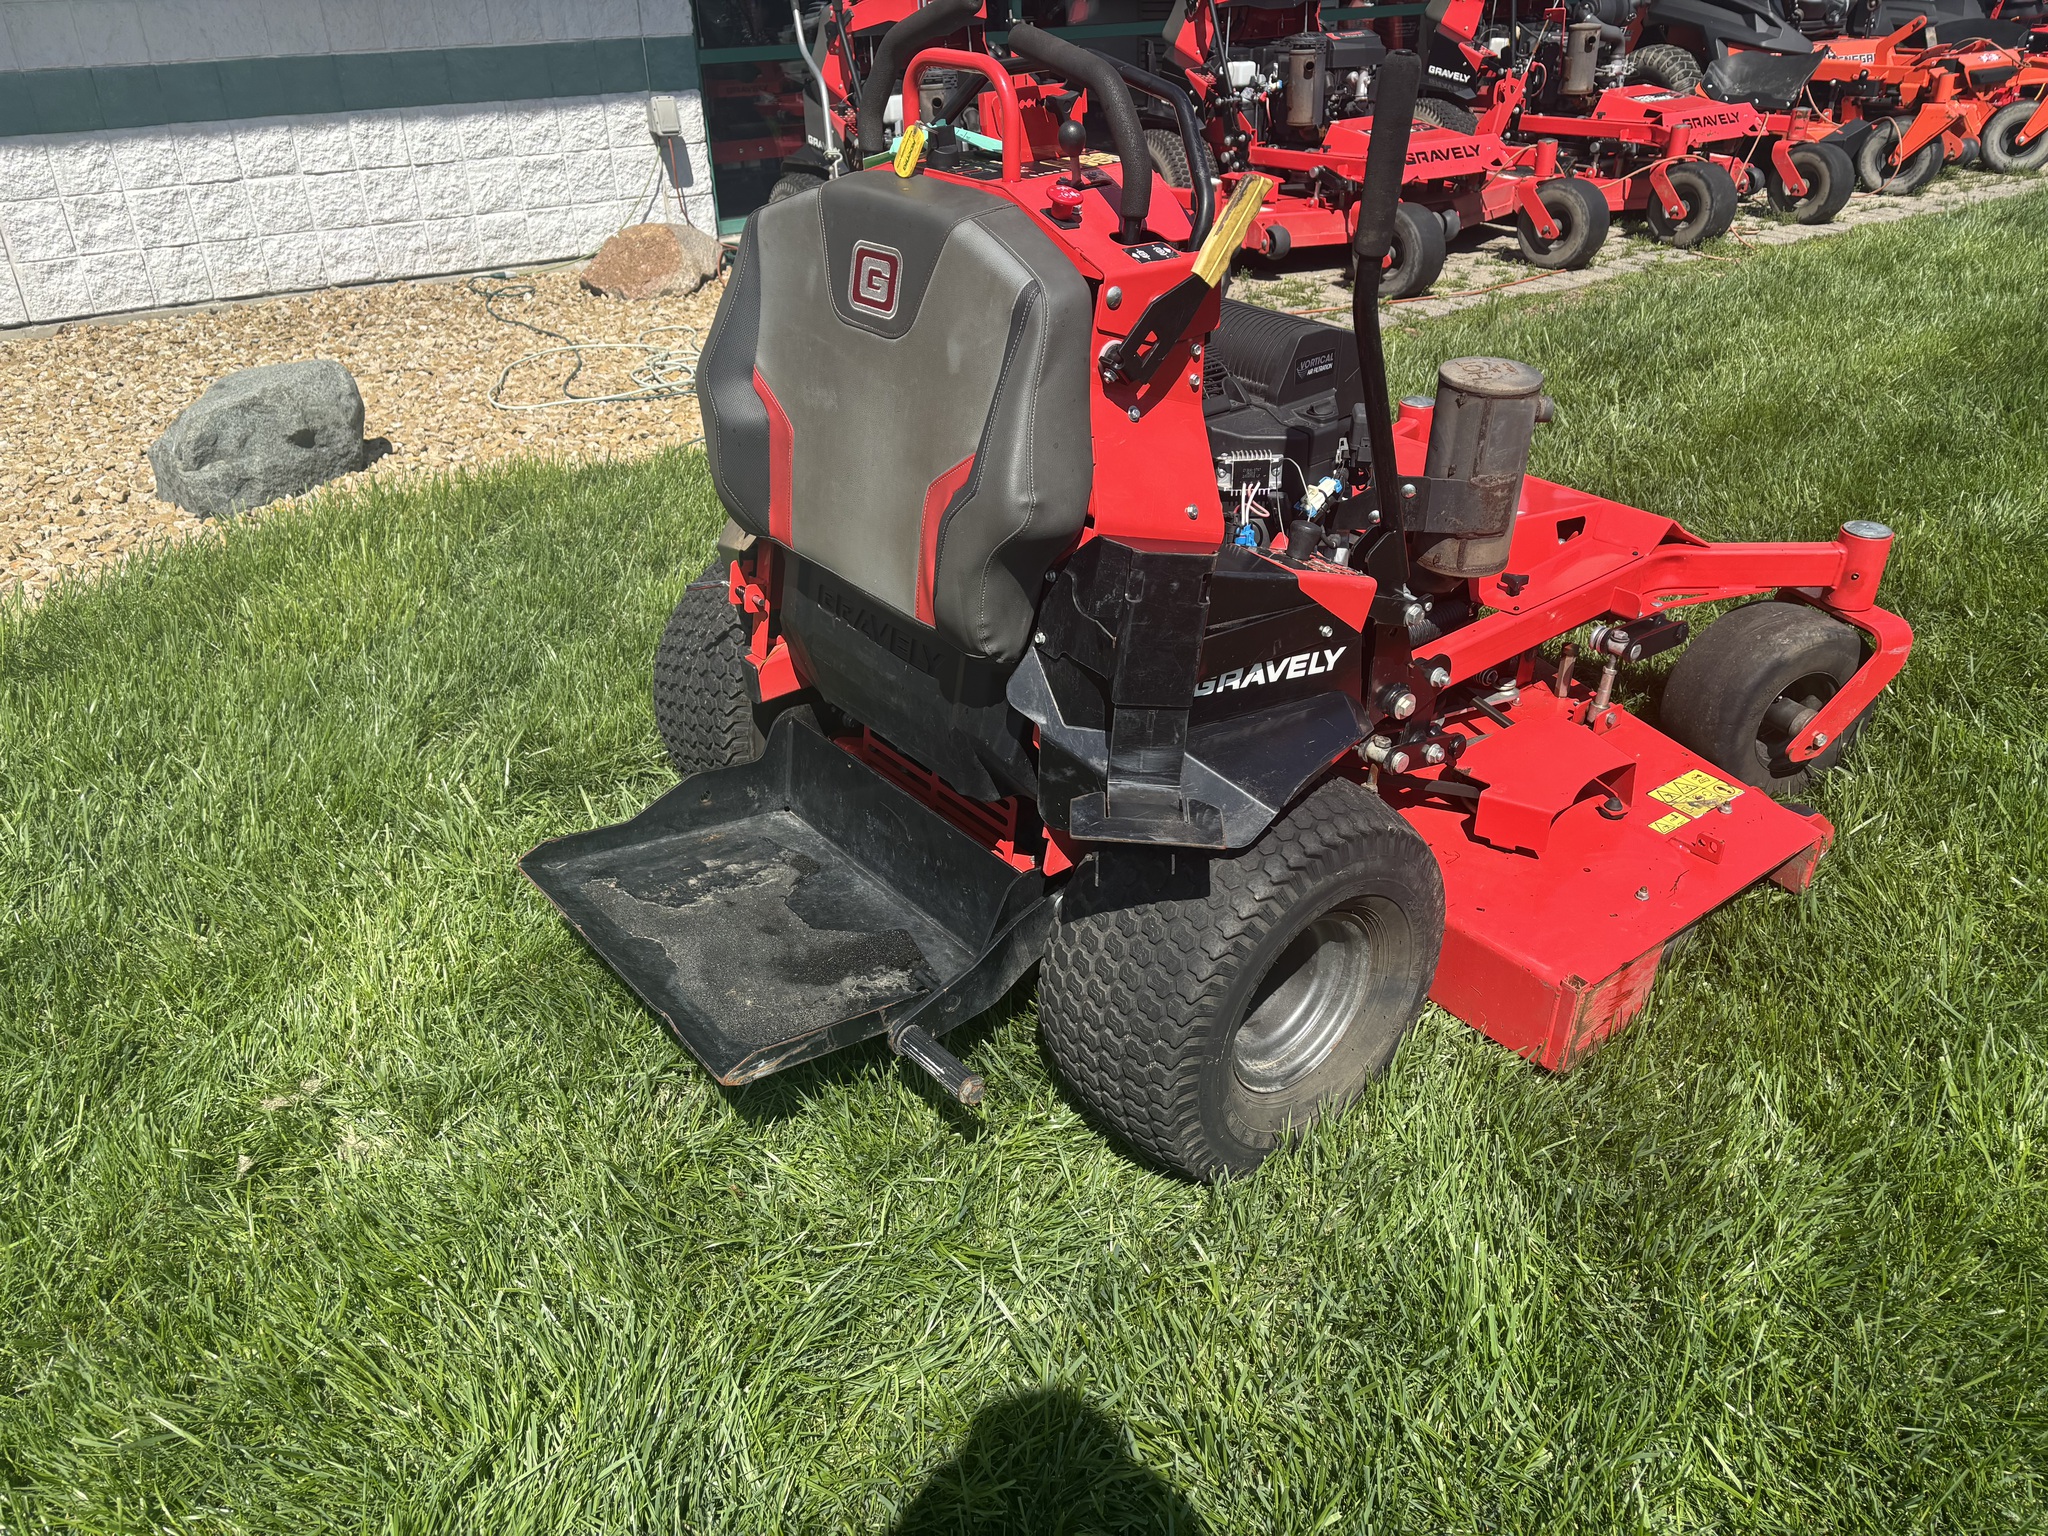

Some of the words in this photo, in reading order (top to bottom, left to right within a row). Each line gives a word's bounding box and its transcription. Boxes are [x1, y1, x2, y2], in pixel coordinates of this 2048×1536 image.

[1428, 65, 1471, 83] GRAVELY
[1682, 111, 1740, 130] GRAVELY
[1405, 144, 1480, 165] GRAVELY
[859, 255, 891, 303] G
[1301, 352, 1334, 370] VORTICAL
[1193, 646, 1347, 697] GRAVELY
